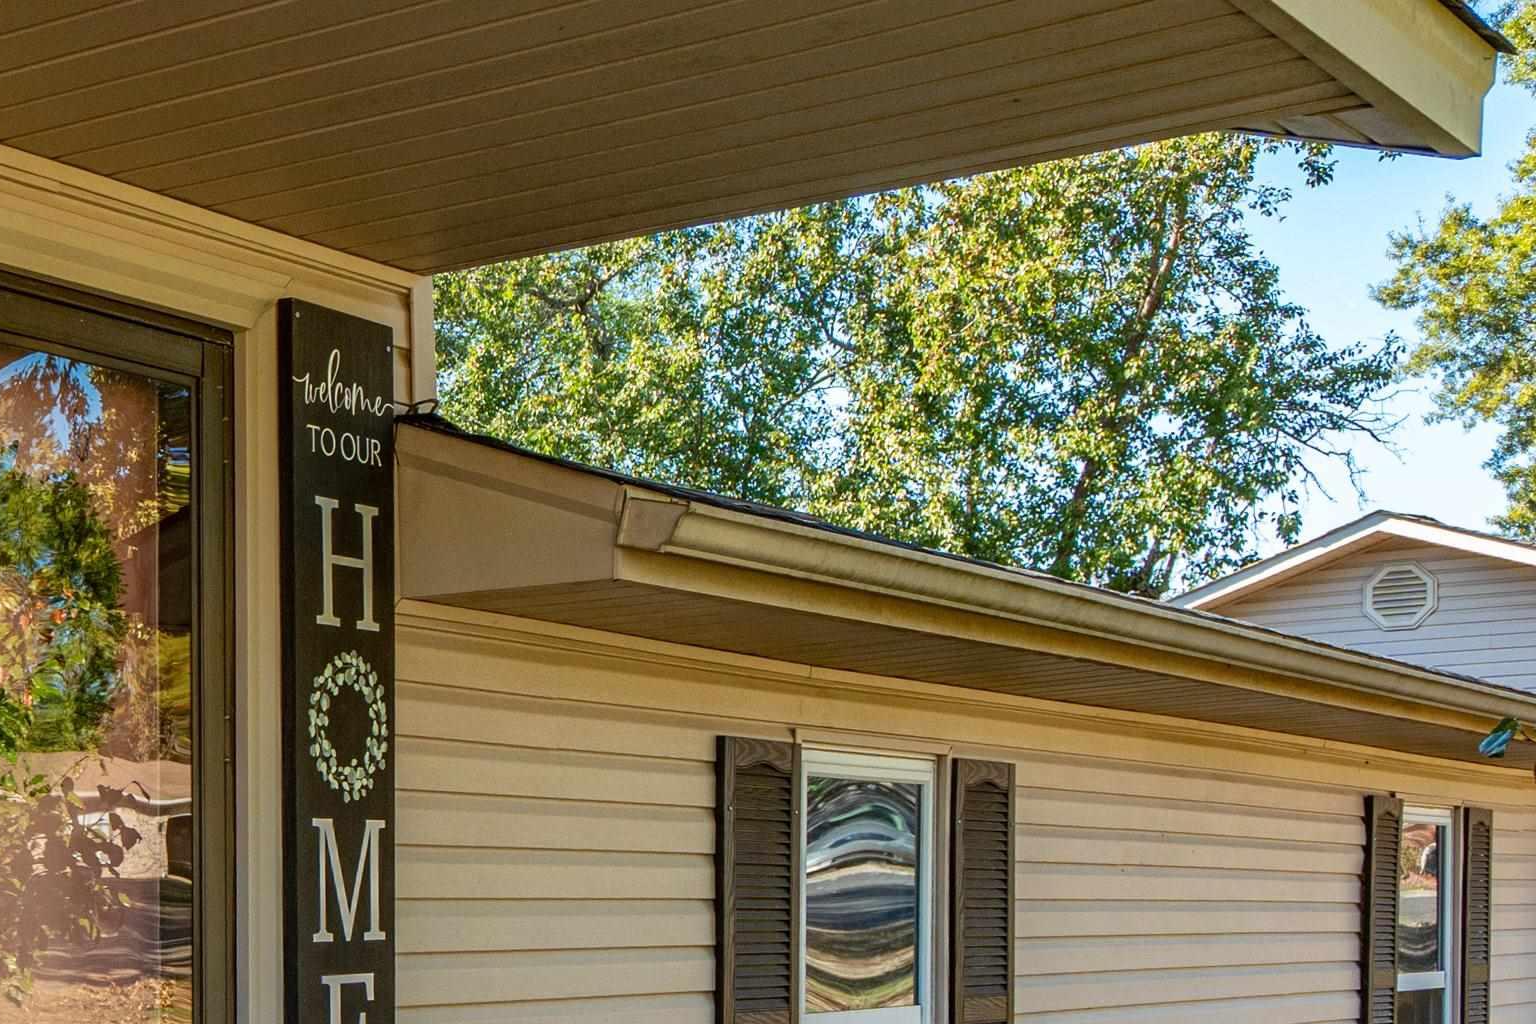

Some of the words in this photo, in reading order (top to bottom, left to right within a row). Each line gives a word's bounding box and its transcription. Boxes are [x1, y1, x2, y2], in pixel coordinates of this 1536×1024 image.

[292, 349, 394, 416] welcome
[306, 424, 336, 456] TO
[340, 432, 382, 467] OUR
